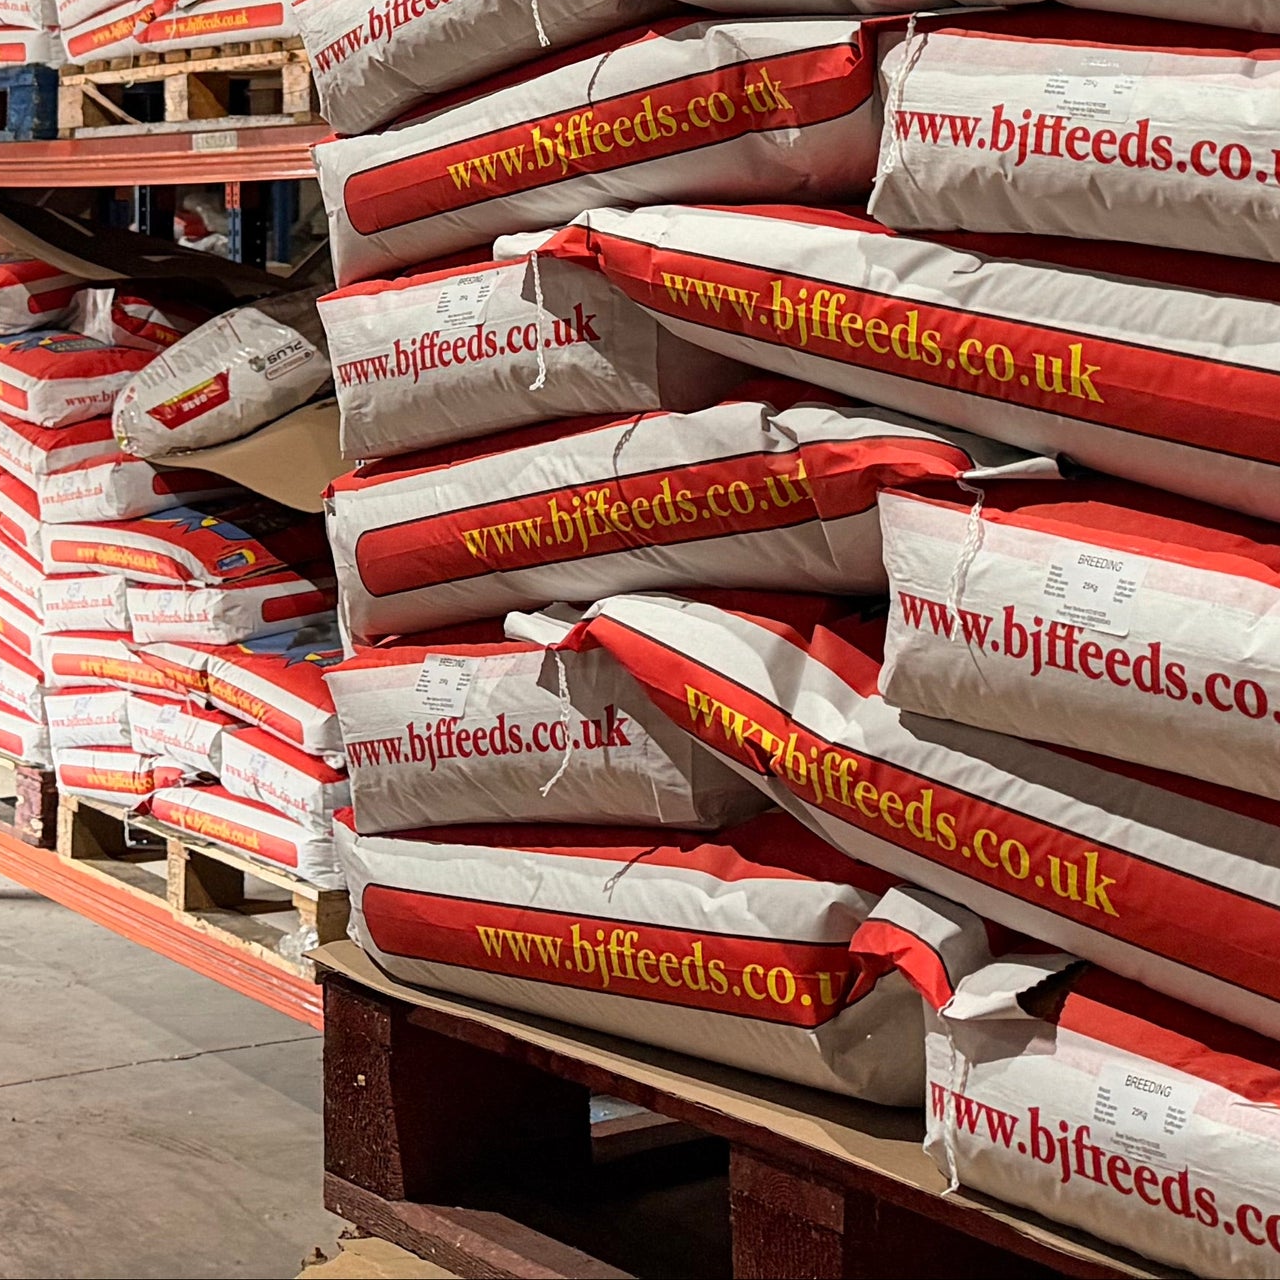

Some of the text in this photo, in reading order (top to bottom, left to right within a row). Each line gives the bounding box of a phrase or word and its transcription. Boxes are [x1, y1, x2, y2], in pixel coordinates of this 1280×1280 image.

[447, 69, 792, 190] www.bjffeeds.co.uk
[337, 304, 600, 388] www.bjffeeds.co.uk
[661, 270, 1105, 408] www.bjffeeds.co.uk
[1077, 554, 1123, 572] BREEDING
[346, 706, 631, 771] www.bjffeeds.co.uk
[1125, 1074, 1172, 1097] BREEDING
